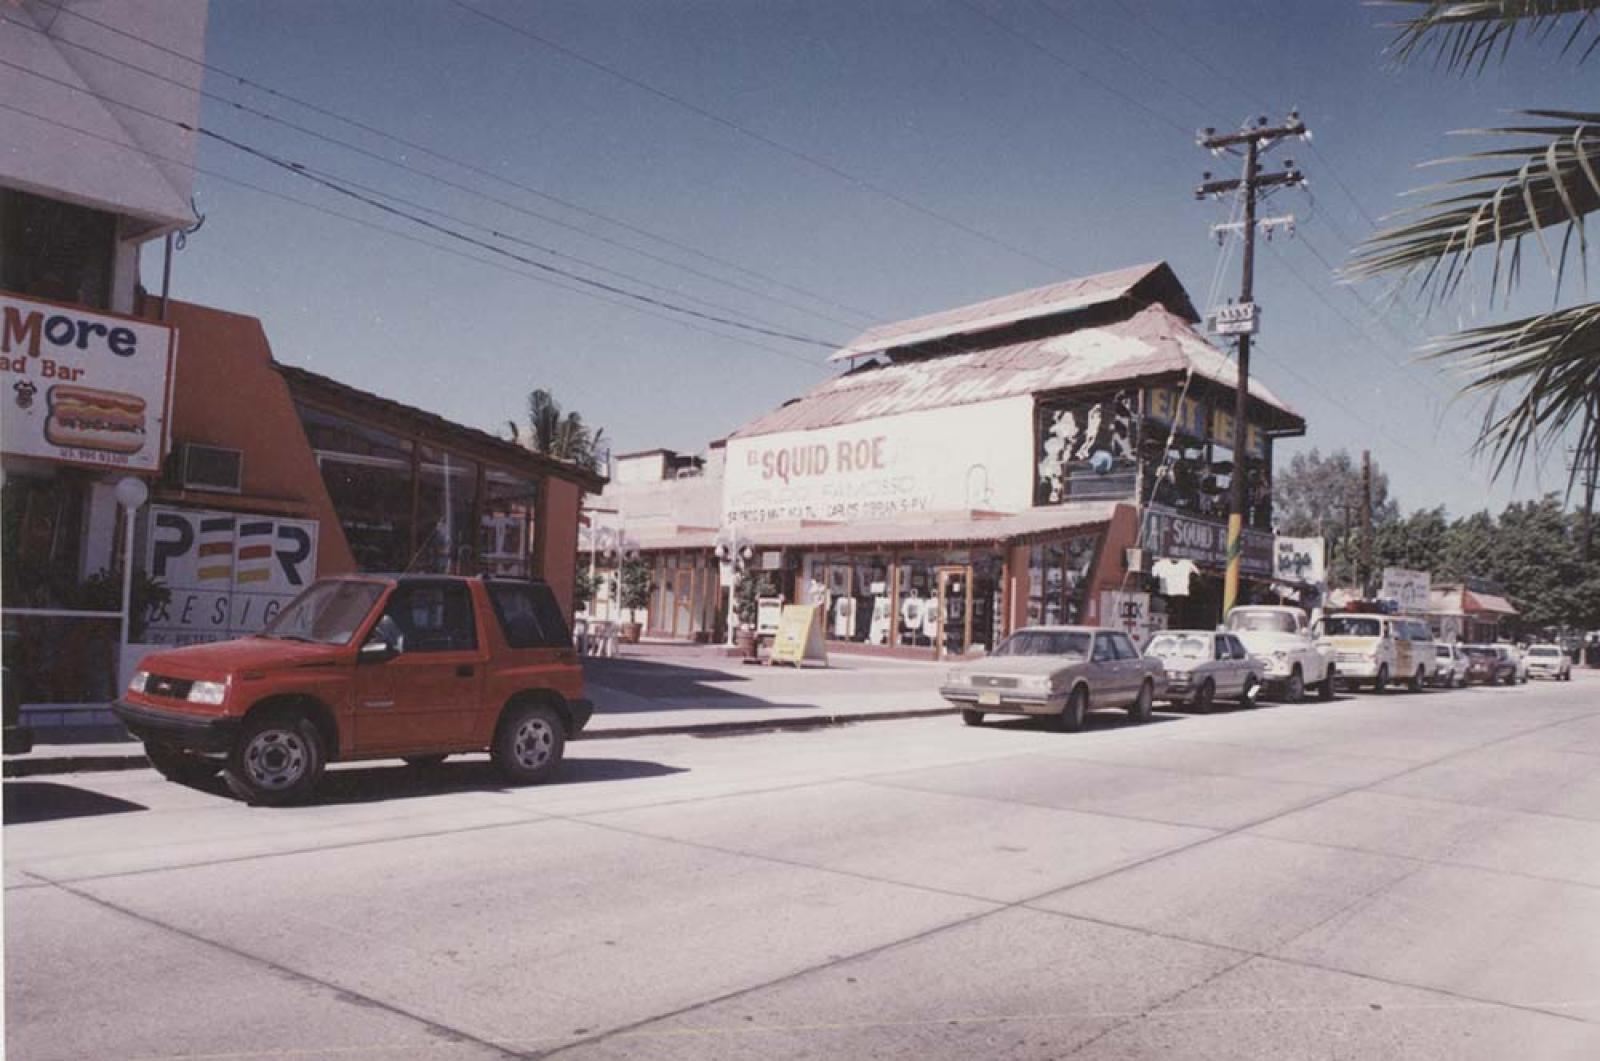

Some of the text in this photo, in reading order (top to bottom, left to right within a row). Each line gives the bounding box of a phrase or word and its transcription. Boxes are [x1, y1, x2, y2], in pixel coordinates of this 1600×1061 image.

[1, 306, 137, 357] More
[41, 358, 85, 381] Bar
[762, 445, 829, 485] SQUID
[836, 436, 887, 473] ROE
[153, 513, 311, 585] PEER
